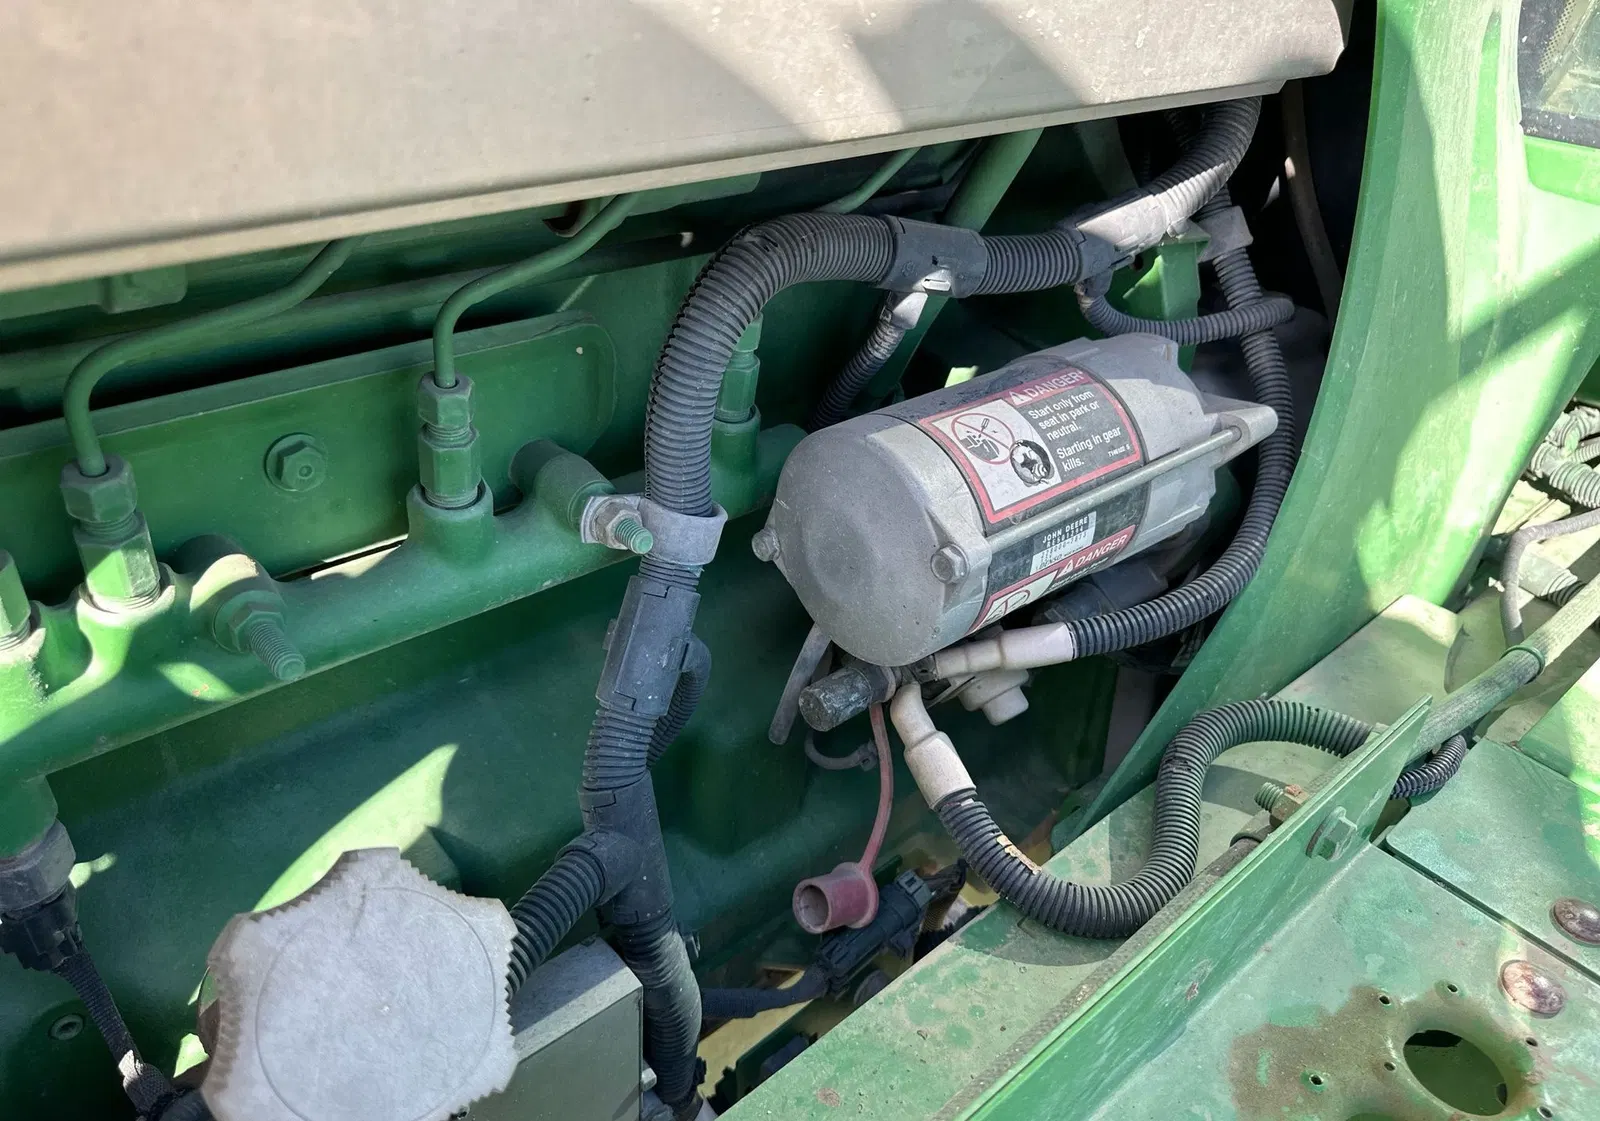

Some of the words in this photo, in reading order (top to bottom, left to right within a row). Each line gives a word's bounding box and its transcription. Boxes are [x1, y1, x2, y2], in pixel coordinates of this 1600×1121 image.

[1024, 371, 1085, 398] DANGER
[1028, 405, 1054, 420] Start
[1054, 396, 1072, 411] only
[1070, 390, 1094, 405] from
[1038, 416, 1059, 430] seat
[1060, 411, 1070, 425] in
[1069, 404, 1089, 421] park
[1089, 400, 1100, 410] or
[1046, 421, 1082, 442] neutral.
[1056, 438, 1093, 459] Starting
[1093, 434, 1103, 445] in
[1103, 427, 1122, 446] gear
[1061, 457, 1085, 472] kills.
[1042, 528, 1062, 544] JOHN
[1065, 516, 1088, 533] DEERE
[1075, 534, 1128, 568] DANGER
